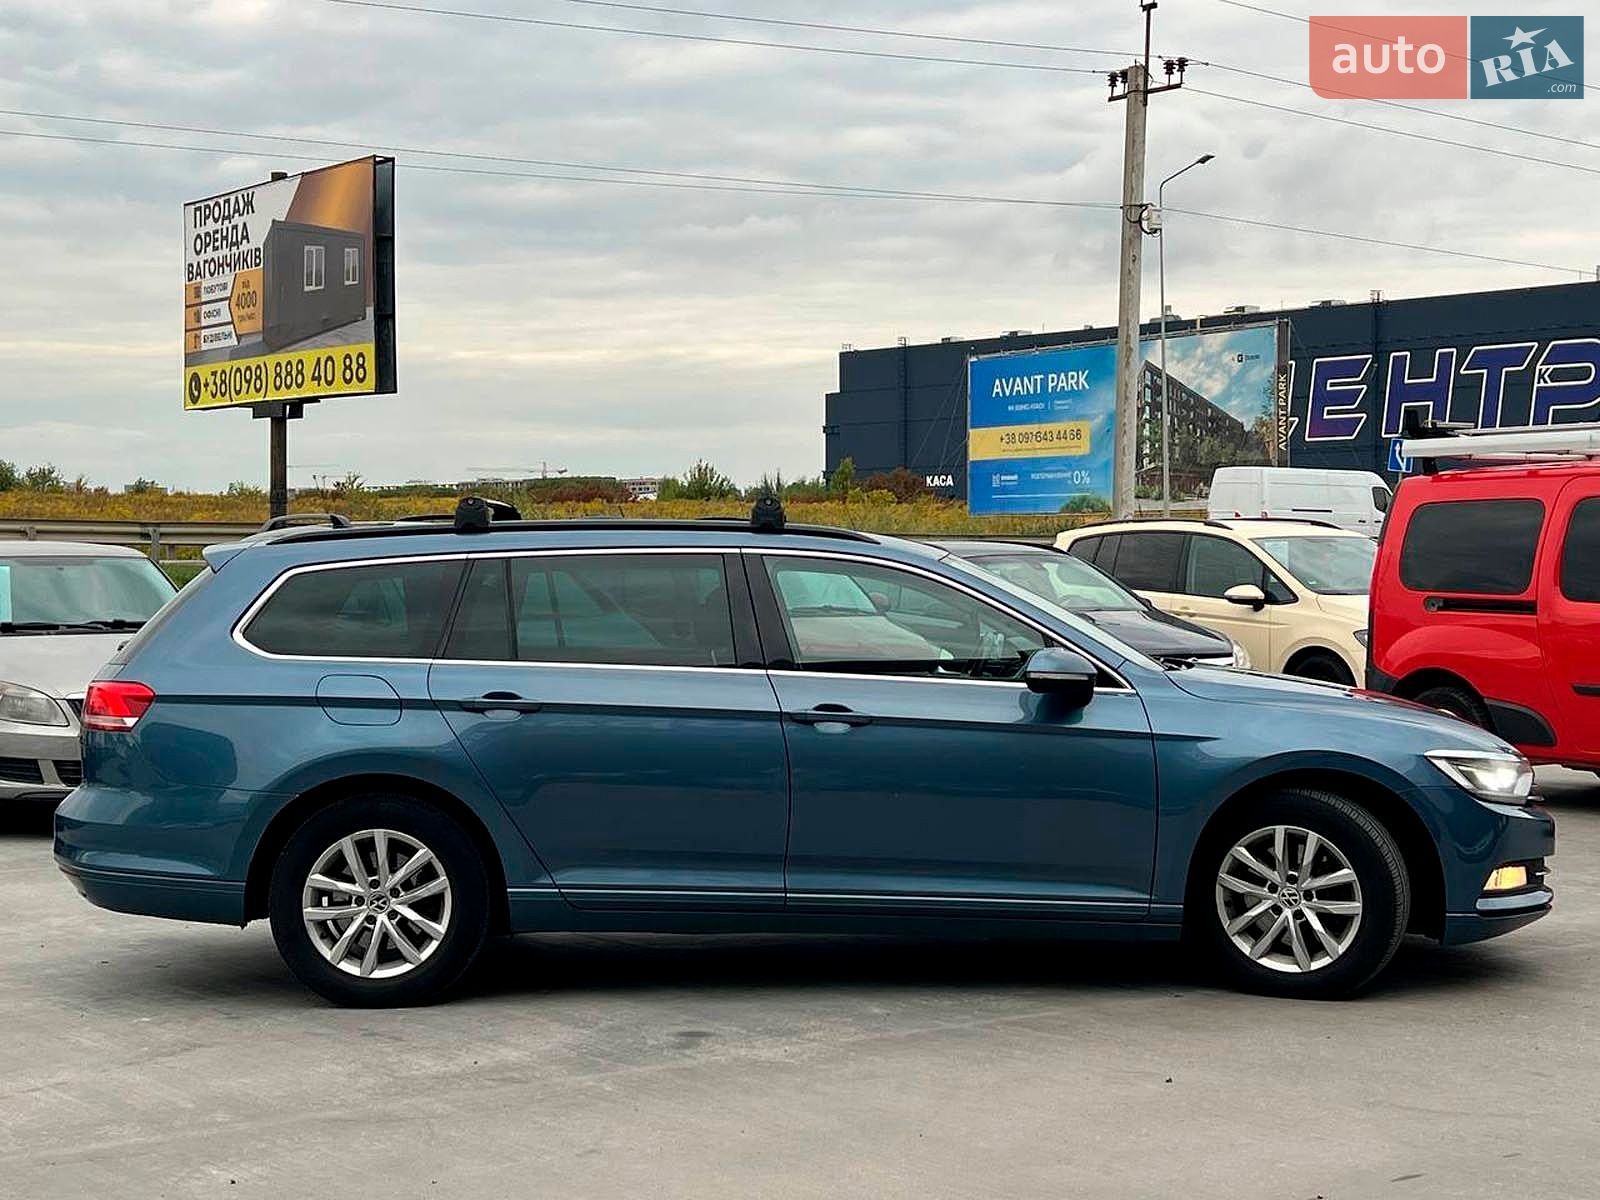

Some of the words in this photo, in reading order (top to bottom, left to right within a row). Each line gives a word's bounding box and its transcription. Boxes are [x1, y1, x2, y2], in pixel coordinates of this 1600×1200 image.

[193, 191, 255, 229] ПРОДАЖ
[193, 221, 250, 256] ОРЕНДА
[187, 247, 262, 282] ВАГОНЧИКІВ
[235, 290, 257, 310] 4000
[203, 361, 269, 402] +38(098)
[273, 358, 305, 392] 888
[311, 355, 336, 387] 40
[342, 352, 367, 385] 88
[991, 375, 1044, 398] AVANT
[1048, 369, 1090, 393] PARK
[1278, 373, 1288, 406] PARK
[1288, 338, 1600, 441] ЕНТР
[1278, 408, 1288, 451] AVANT
[925, 474, 954, 487] КАСА
[1072, 469, 1091, 485] 0%
